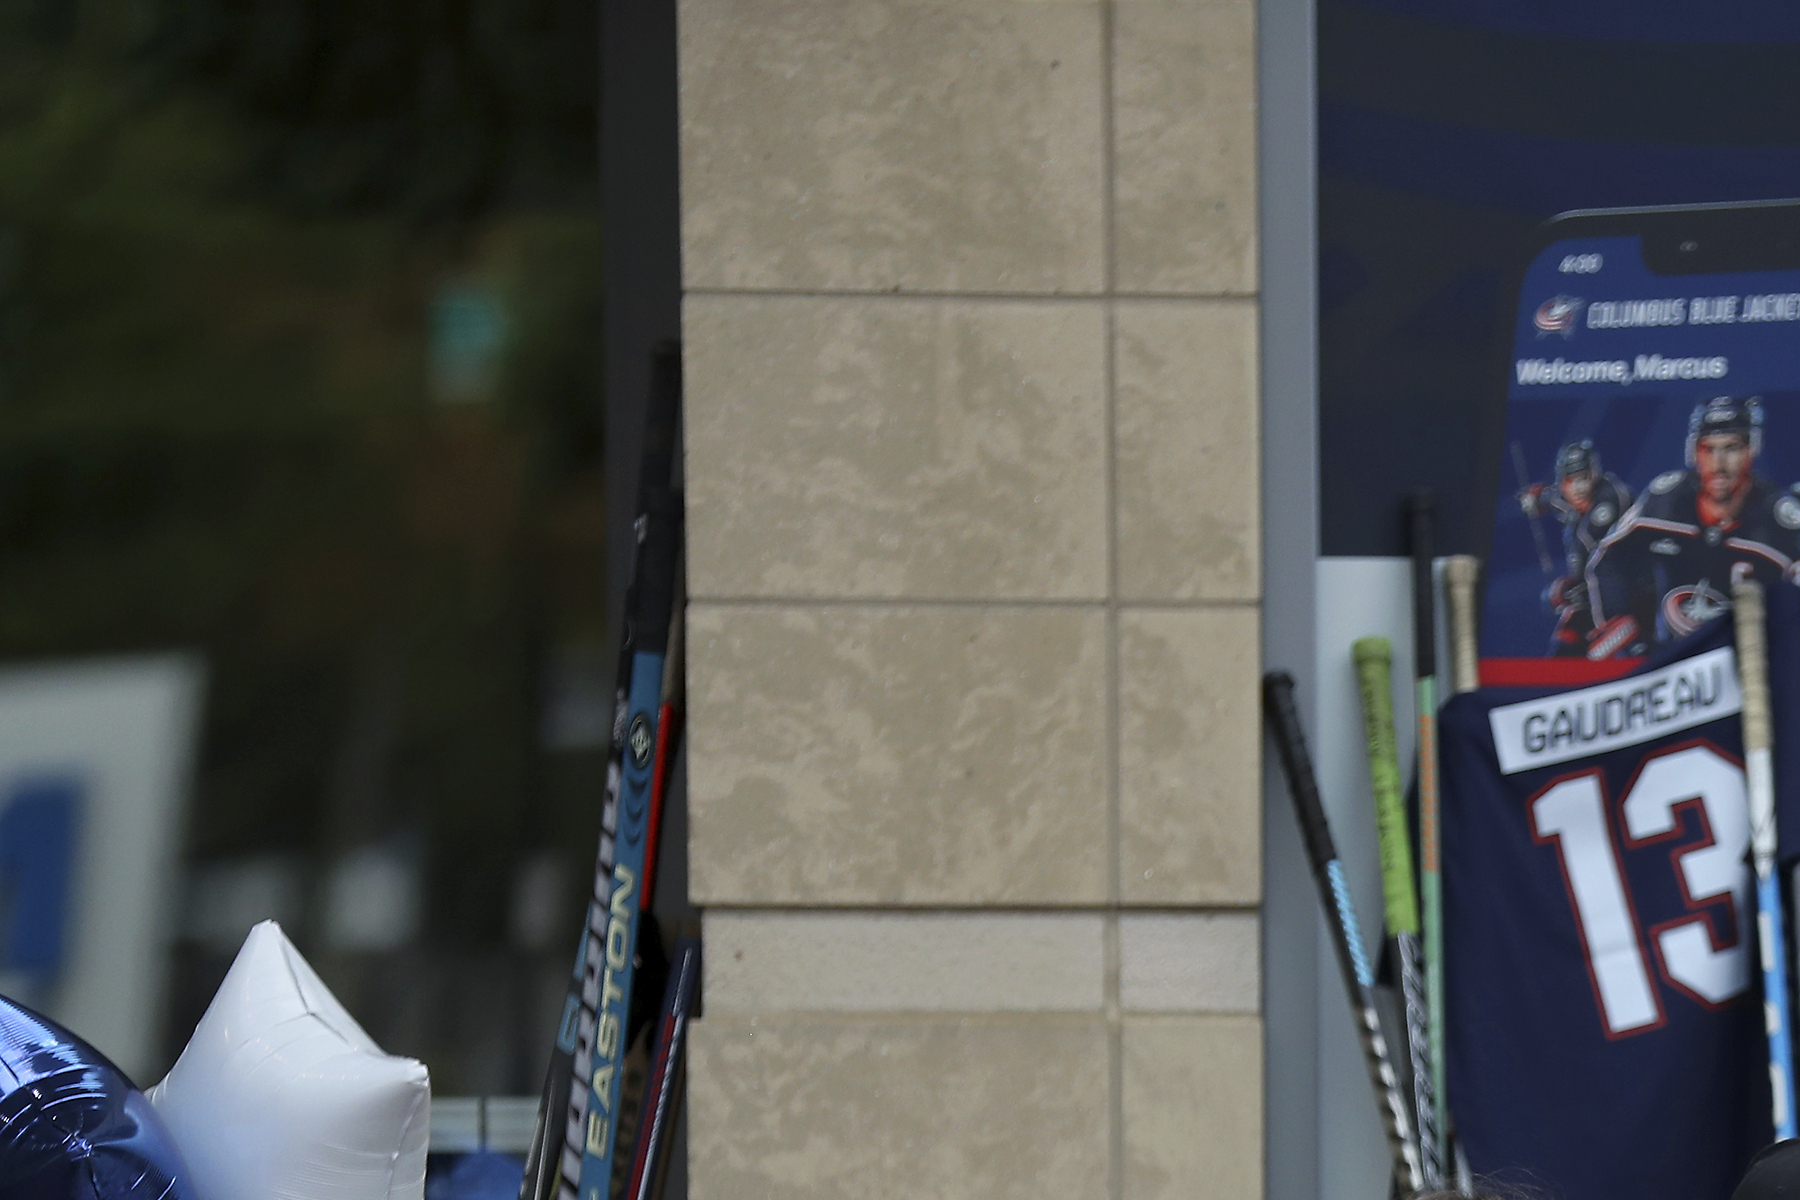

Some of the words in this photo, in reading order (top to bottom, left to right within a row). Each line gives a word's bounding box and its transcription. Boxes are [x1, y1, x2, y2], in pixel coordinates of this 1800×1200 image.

[1587, 299, 1687, 329] COLUMBUS
[1688, 296, 1738, 325] BLUE
[1516, 357, 1634, 386] Welcome,
[1634, 353, 1729, 381] Marcus
[1523, 664, 1722, 753] GAUDREAU
[1527, 737, 1752, 1041] 13
[587, 863, 636, 1160] EASTON
